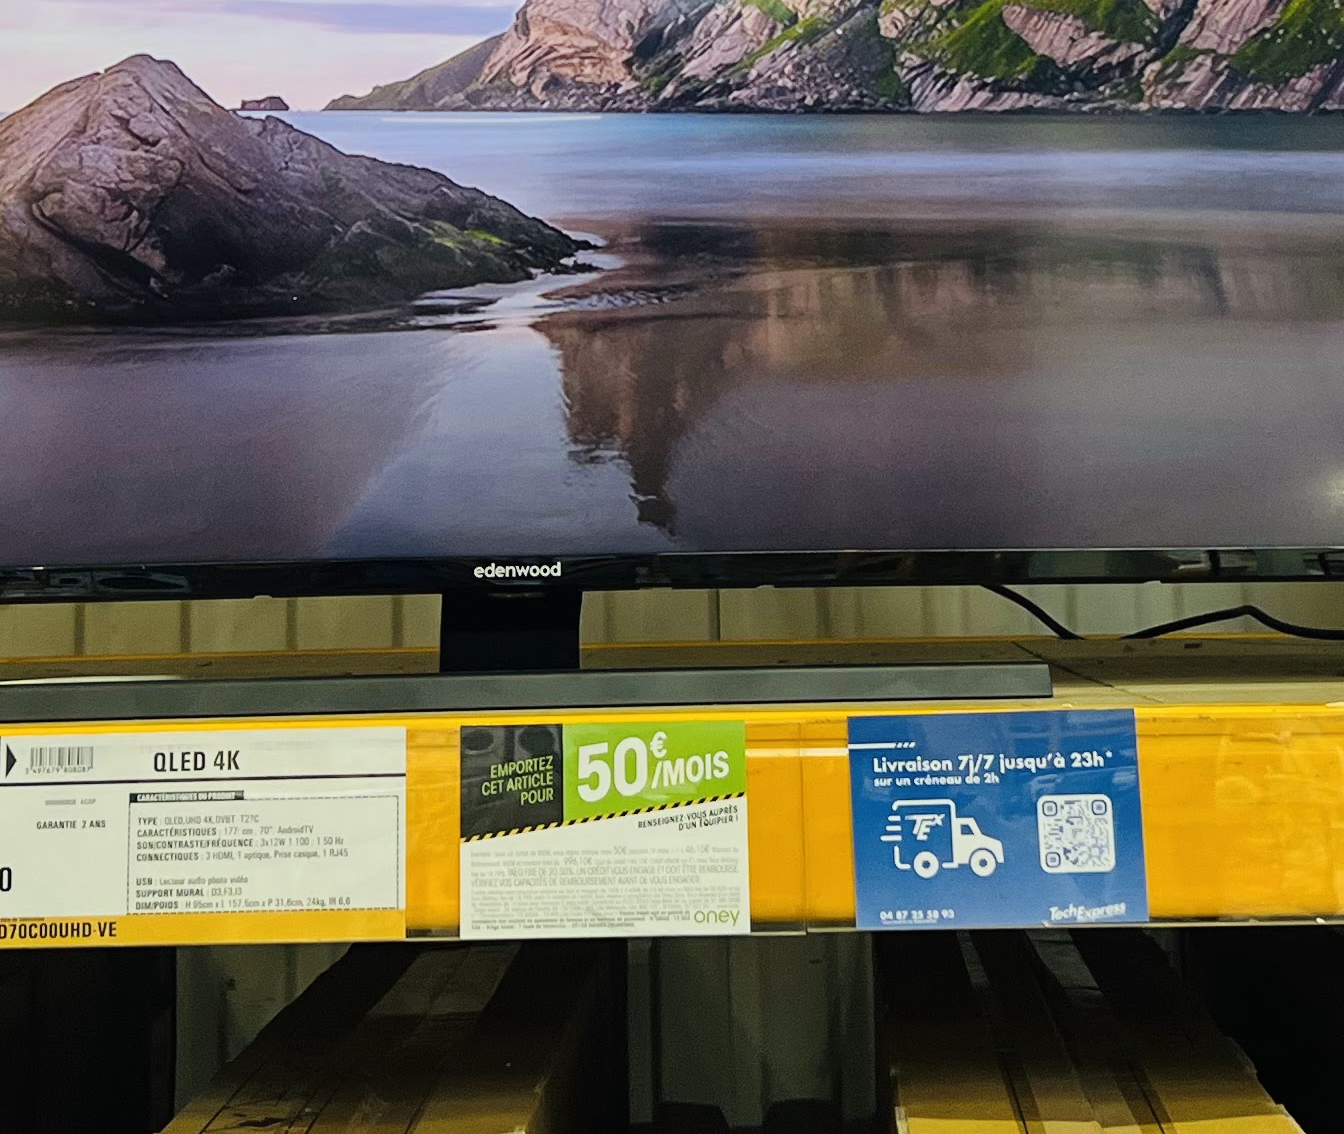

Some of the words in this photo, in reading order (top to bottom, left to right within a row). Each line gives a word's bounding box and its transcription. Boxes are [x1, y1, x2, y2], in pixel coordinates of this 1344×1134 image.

[473, 561, 562, 579] edenwood
[153, 751, 205, 773] QLED
[213, 750, 240, 772] 4K
[490, 755, 553, 779] EMPORTEZ
[576, 737, 649, 802] 50
[651, 750, 729, 790] /MOIS
[873, 756, 953, 773] Livraison
[957, 753, 995, 776] 7j/7
[999, 752, 1066, 774] jusqu'à
[481, 778, 504, 796] CET
[506, 772, 553, 793] ARTICLE
[873, 777, 893, 787] sur
[896, 776, 911, 786] un
[913, 774, 962, 786] créneau
[965, 772, 980, 785] de
[983, 772, 1000, 784] 2h
[520, 789, 553, 806] POUR
[709, 803, 738, 817] AUPRÈS
[36, 820, 77, 829] GARANTIE
[81, 820, 87, 828] 2
[89, 819, 106, 828] ANS
[138, 817, 157, 825] TYPE
[678, 821, 696, 831] D'UN
[699, 814, 734, 827] ÉQUIPIER
[137, 827, 216, 837] CARACTÉRISTIQUES
[136, 852, 199, 862] CONNECTIQUES
[274, 850, 292, 859] Prise
[329, 849, 348, 858] RJ45
[136, 878, 153, 886] USB
[136, 889, 173, 898] SUPPORT
[176, 888, 204, 897] MURAL
[136, 900, 179, 910] DIM/POIDS
[1049, 902, 1126, 922] TechExpress
[694, 908, 740, 926] oney
